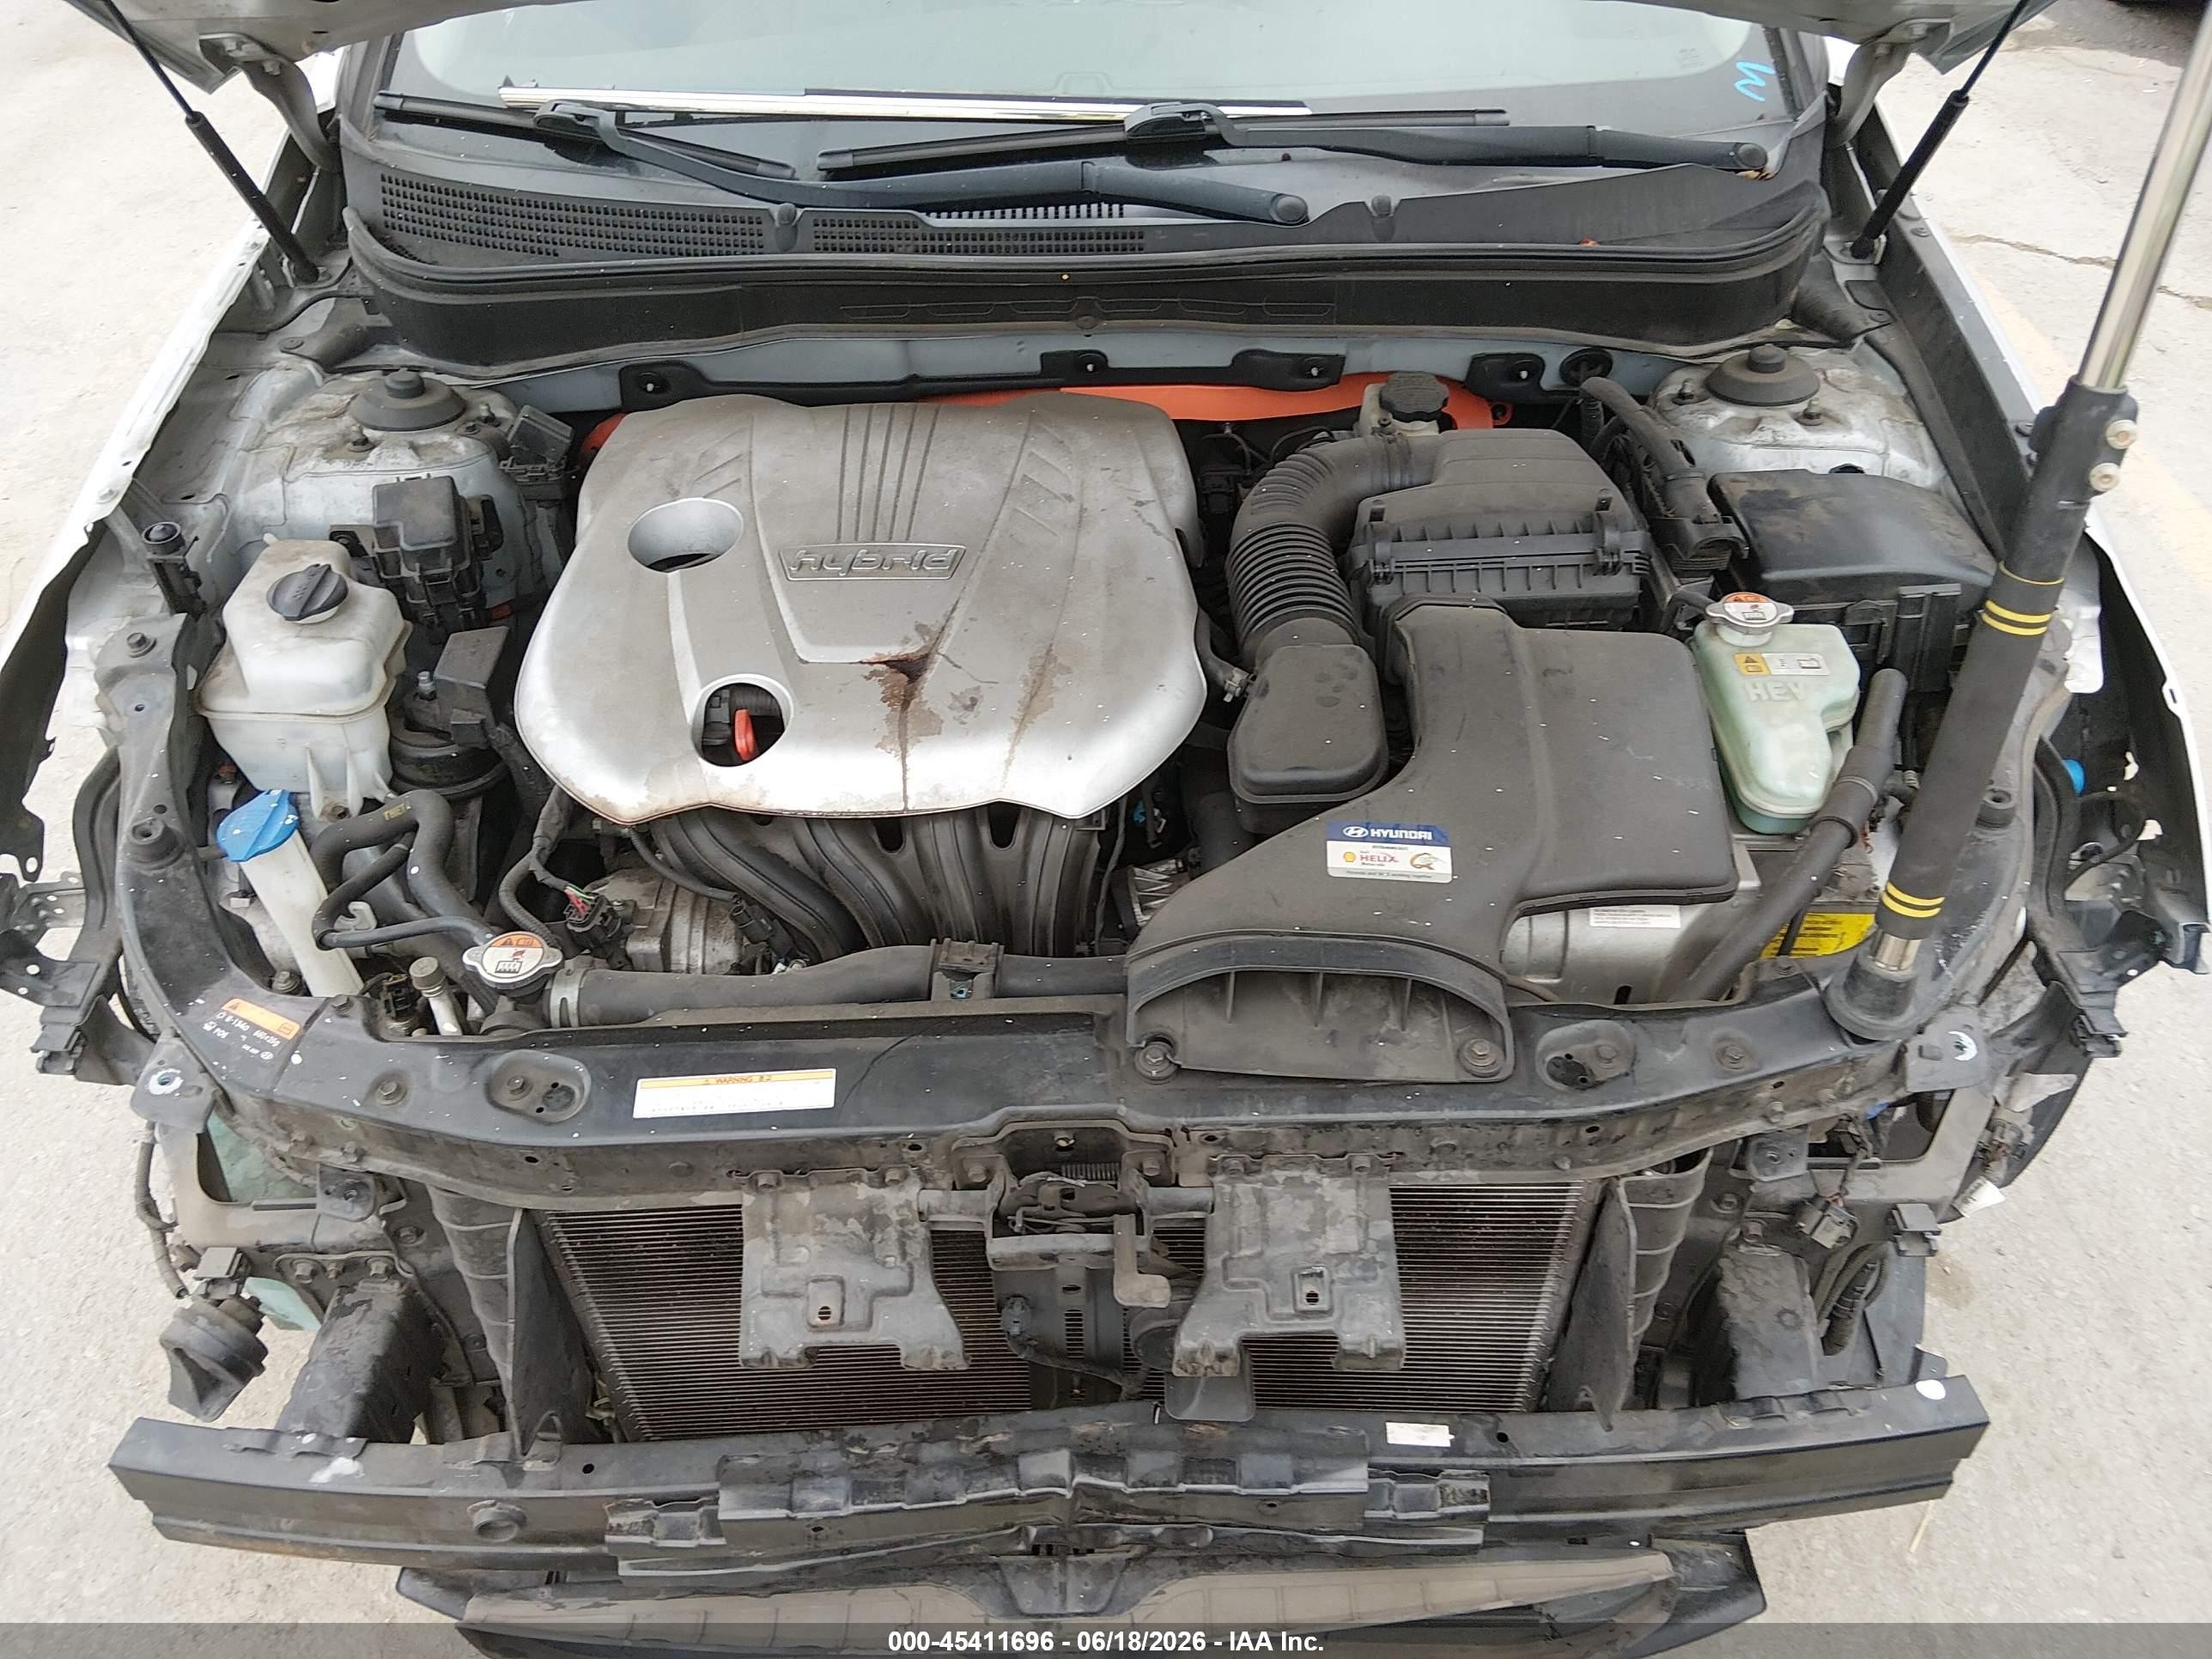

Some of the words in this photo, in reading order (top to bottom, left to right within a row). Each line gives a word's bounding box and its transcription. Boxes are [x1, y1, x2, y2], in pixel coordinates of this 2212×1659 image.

[789, 548, 958, 576] hybrid
[1744, 681, 1807, 702] HEV
[1370, 829, 1433, 841] HYUNDAI
[1360, 854, 1400, 863] HELIX
[715, 1076, 753, 1085] WARNING
